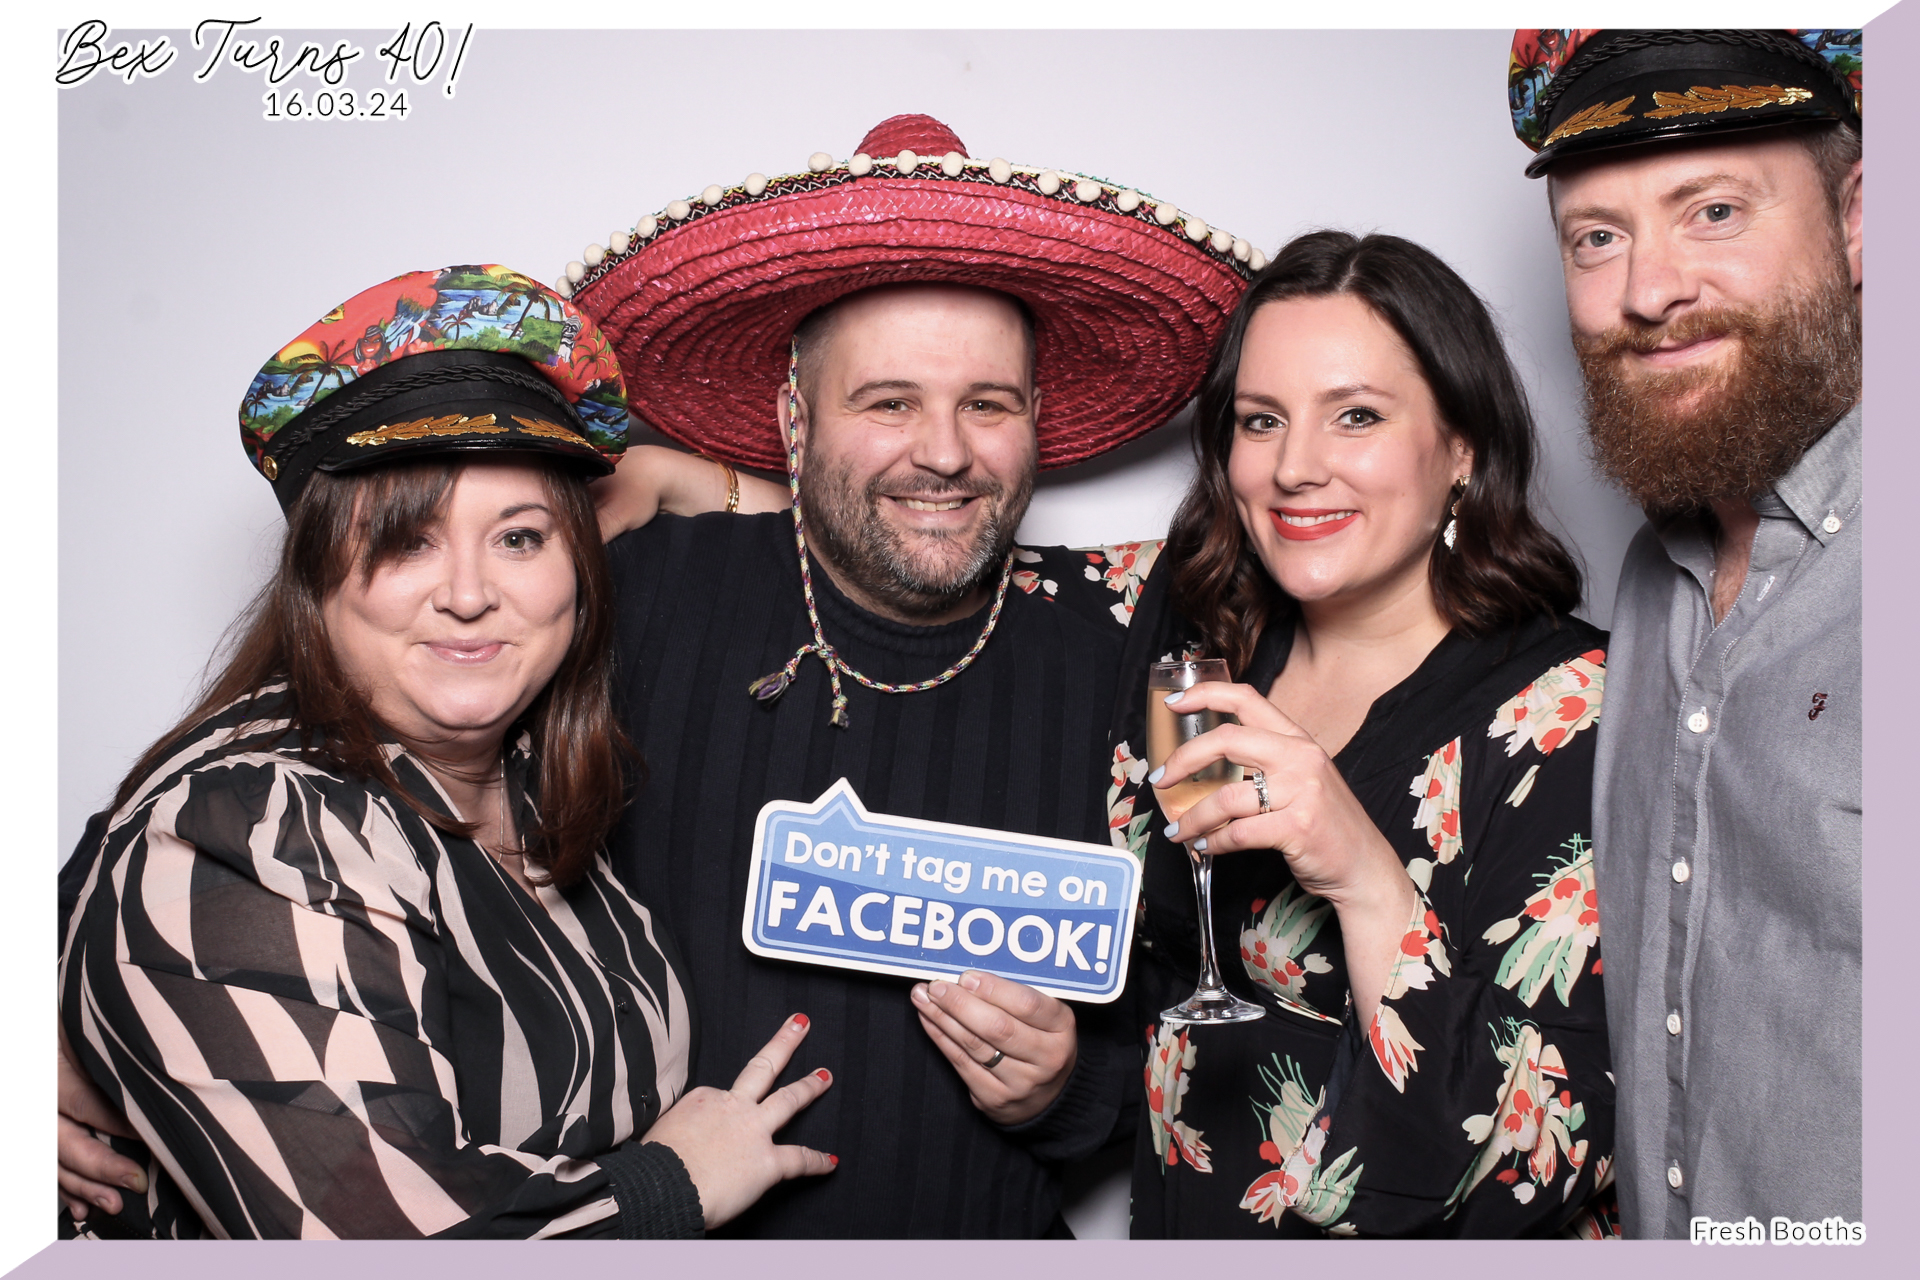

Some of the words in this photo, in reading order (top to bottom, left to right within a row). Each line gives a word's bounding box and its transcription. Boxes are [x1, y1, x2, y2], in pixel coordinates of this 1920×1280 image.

[784, 831, 891, 876] Don't
[901, 847, 972, 894] tag
[981, 865, 1048, 897] me
[1058, 876, 1108, 906] on
[767, 880, 1113, 975] FACEBOOK!
